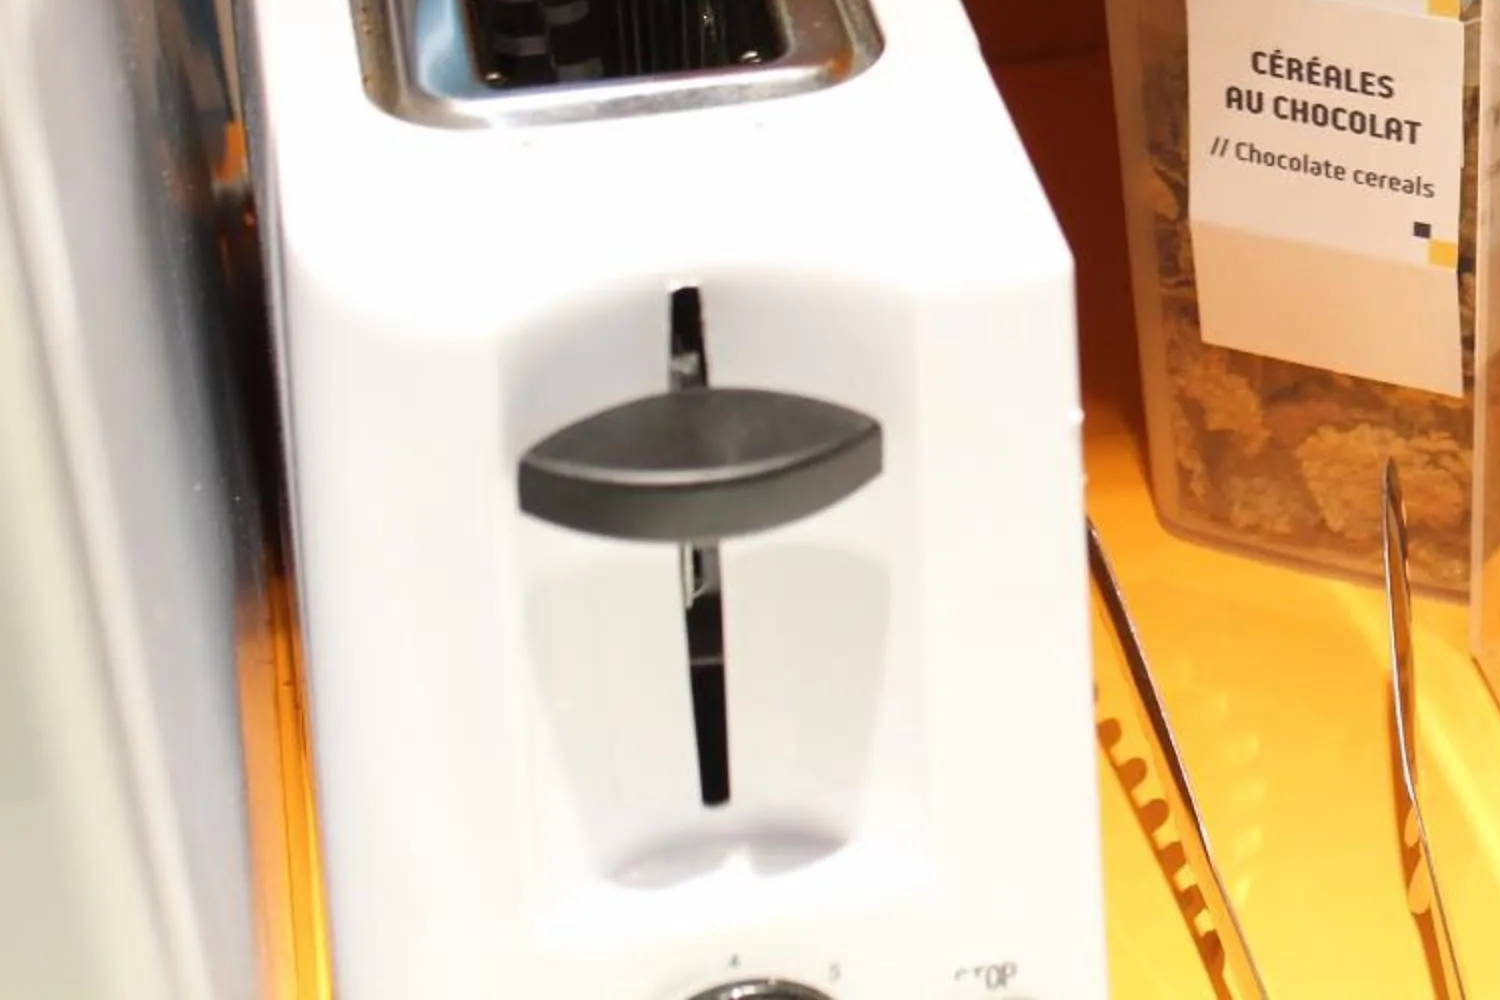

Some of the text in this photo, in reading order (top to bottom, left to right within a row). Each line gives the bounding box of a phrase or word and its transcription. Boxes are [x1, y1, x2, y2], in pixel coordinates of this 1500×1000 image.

[1251, 50, 1394, 98] CÉRÉALES
[1225, 86, 1422, 144] AU CHOCOLAT
[1235, 141, 1345, 180] Chocolate
[1353, 168, 1435, 198] cereals
